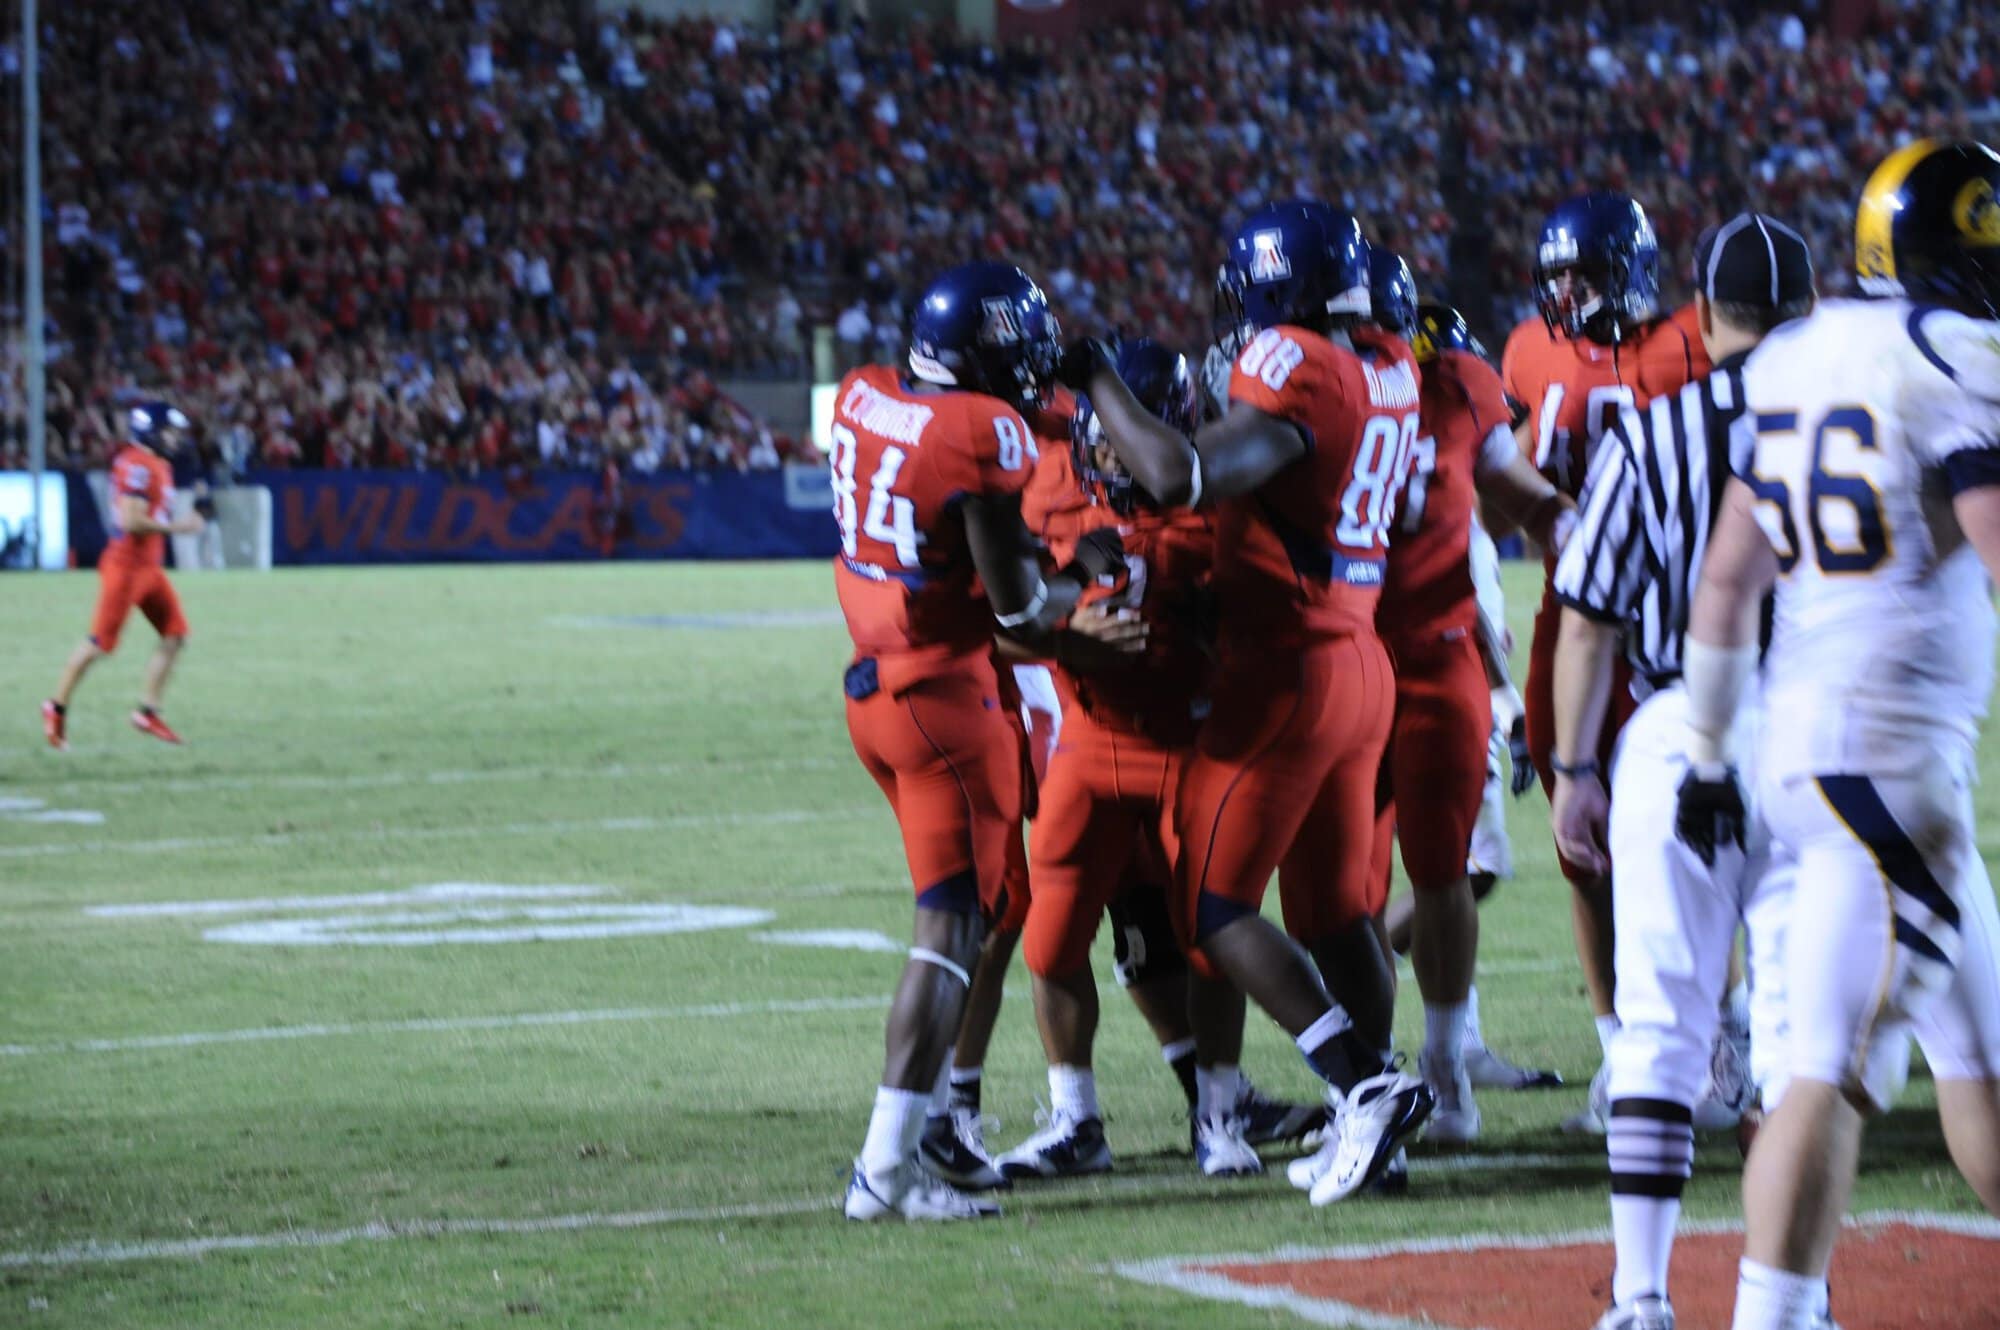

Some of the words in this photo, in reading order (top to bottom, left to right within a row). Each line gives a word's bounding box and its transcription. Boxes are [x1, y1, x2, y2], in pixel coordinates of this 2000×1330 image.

[1240, 328, 1304, 392] 88
[284, 484, 692, 552] WILDCAS
[829, 421, 921, 568] 84
[1336, 412, 1420, 549] 88
[1750, 403, 1895, 578] 56
